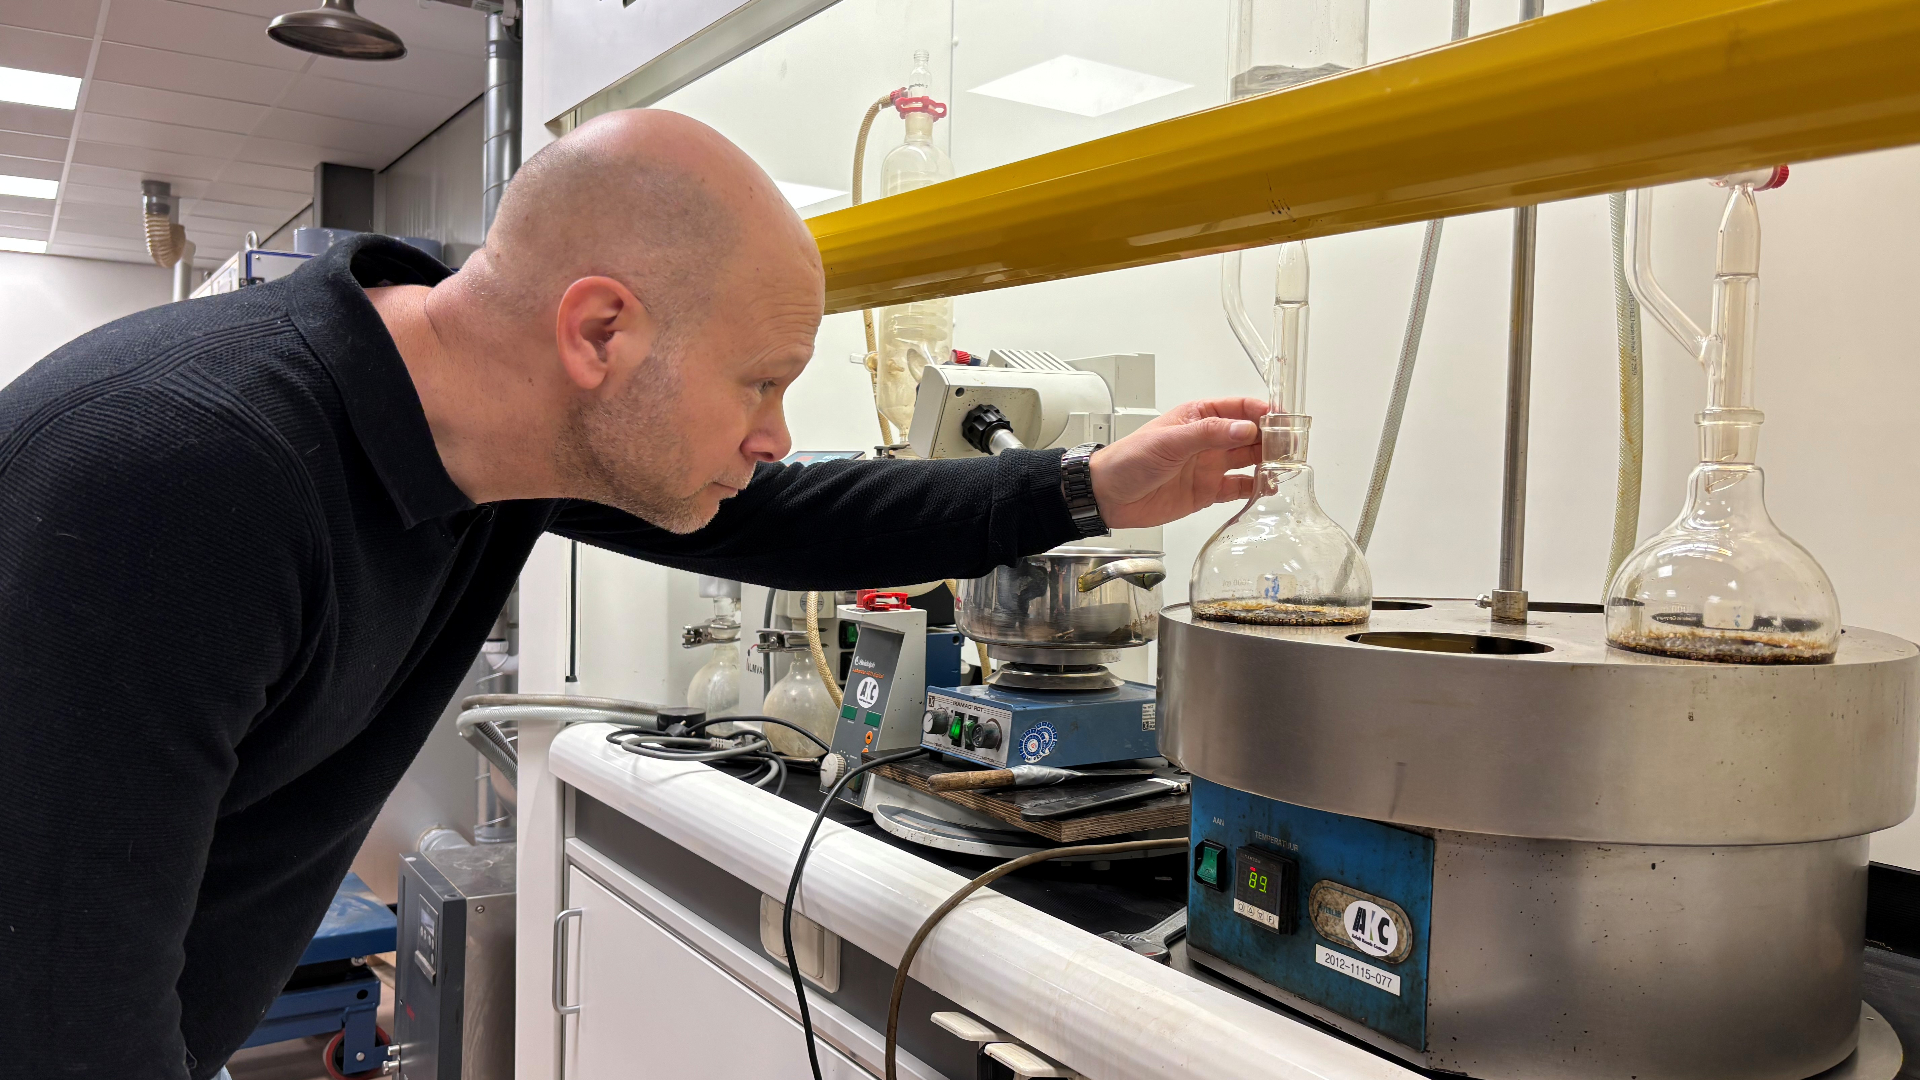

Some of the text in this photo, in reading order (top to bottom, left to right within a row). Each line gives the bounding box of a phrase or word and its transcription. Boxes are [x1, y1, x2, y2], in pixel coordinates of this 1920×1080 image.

[1212, 816, 1225, 827] AAN
[1254, 830, 1299, 853] TEMPERATUUR
[1324, 952, 1393, 988] 2012-1115-077
